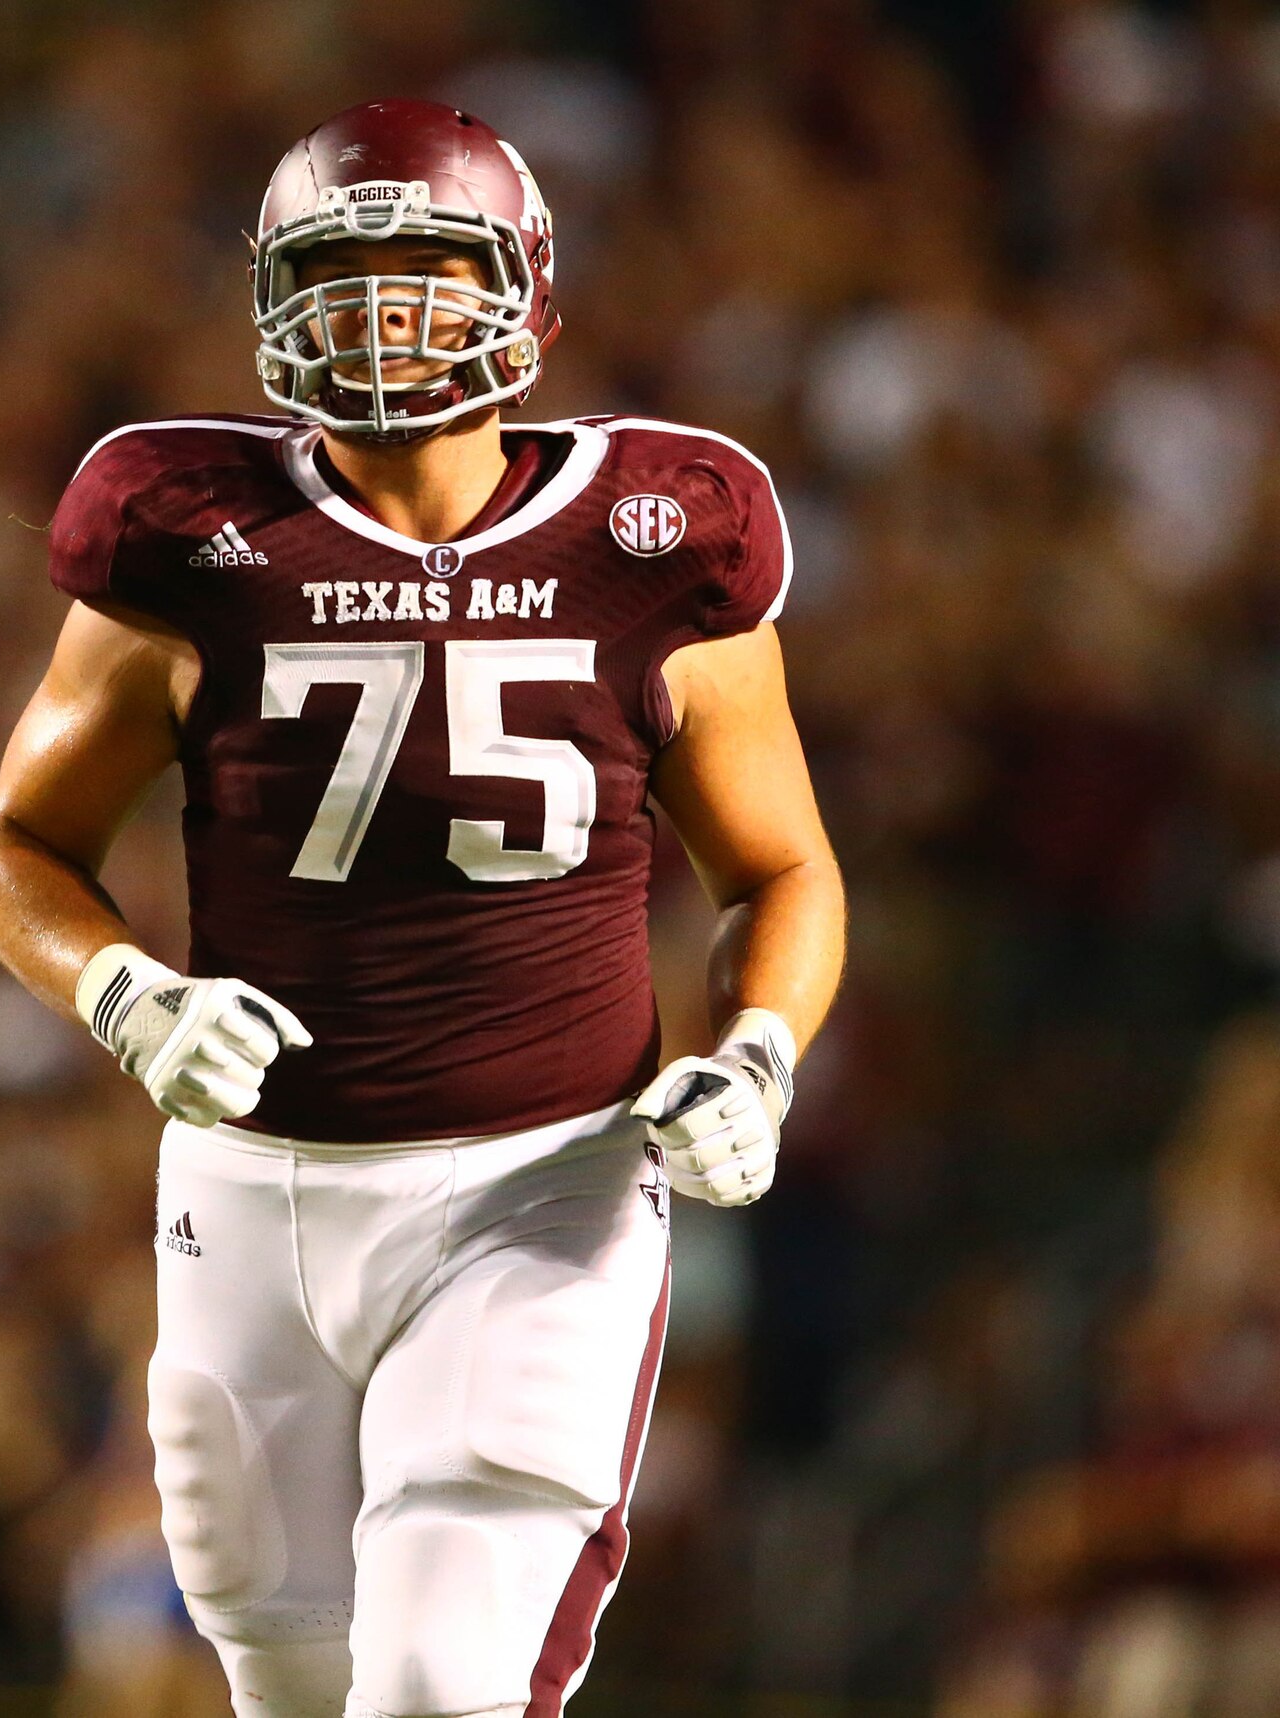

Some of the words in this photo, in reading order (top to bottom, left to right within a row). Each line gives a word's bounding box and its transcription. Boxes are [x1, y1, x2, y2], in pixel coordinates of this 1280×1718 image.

[348, 186, 402, 203] AGGIES
[617, 498, 679, 550] SEC
[188, 549, 269, 568] adidas
[435, 548, 451, 573] C
[302, 579, 450, 624] TEXAS
[465, 578, 558, 620] A&M
[260, 638, 597, 883] 75
